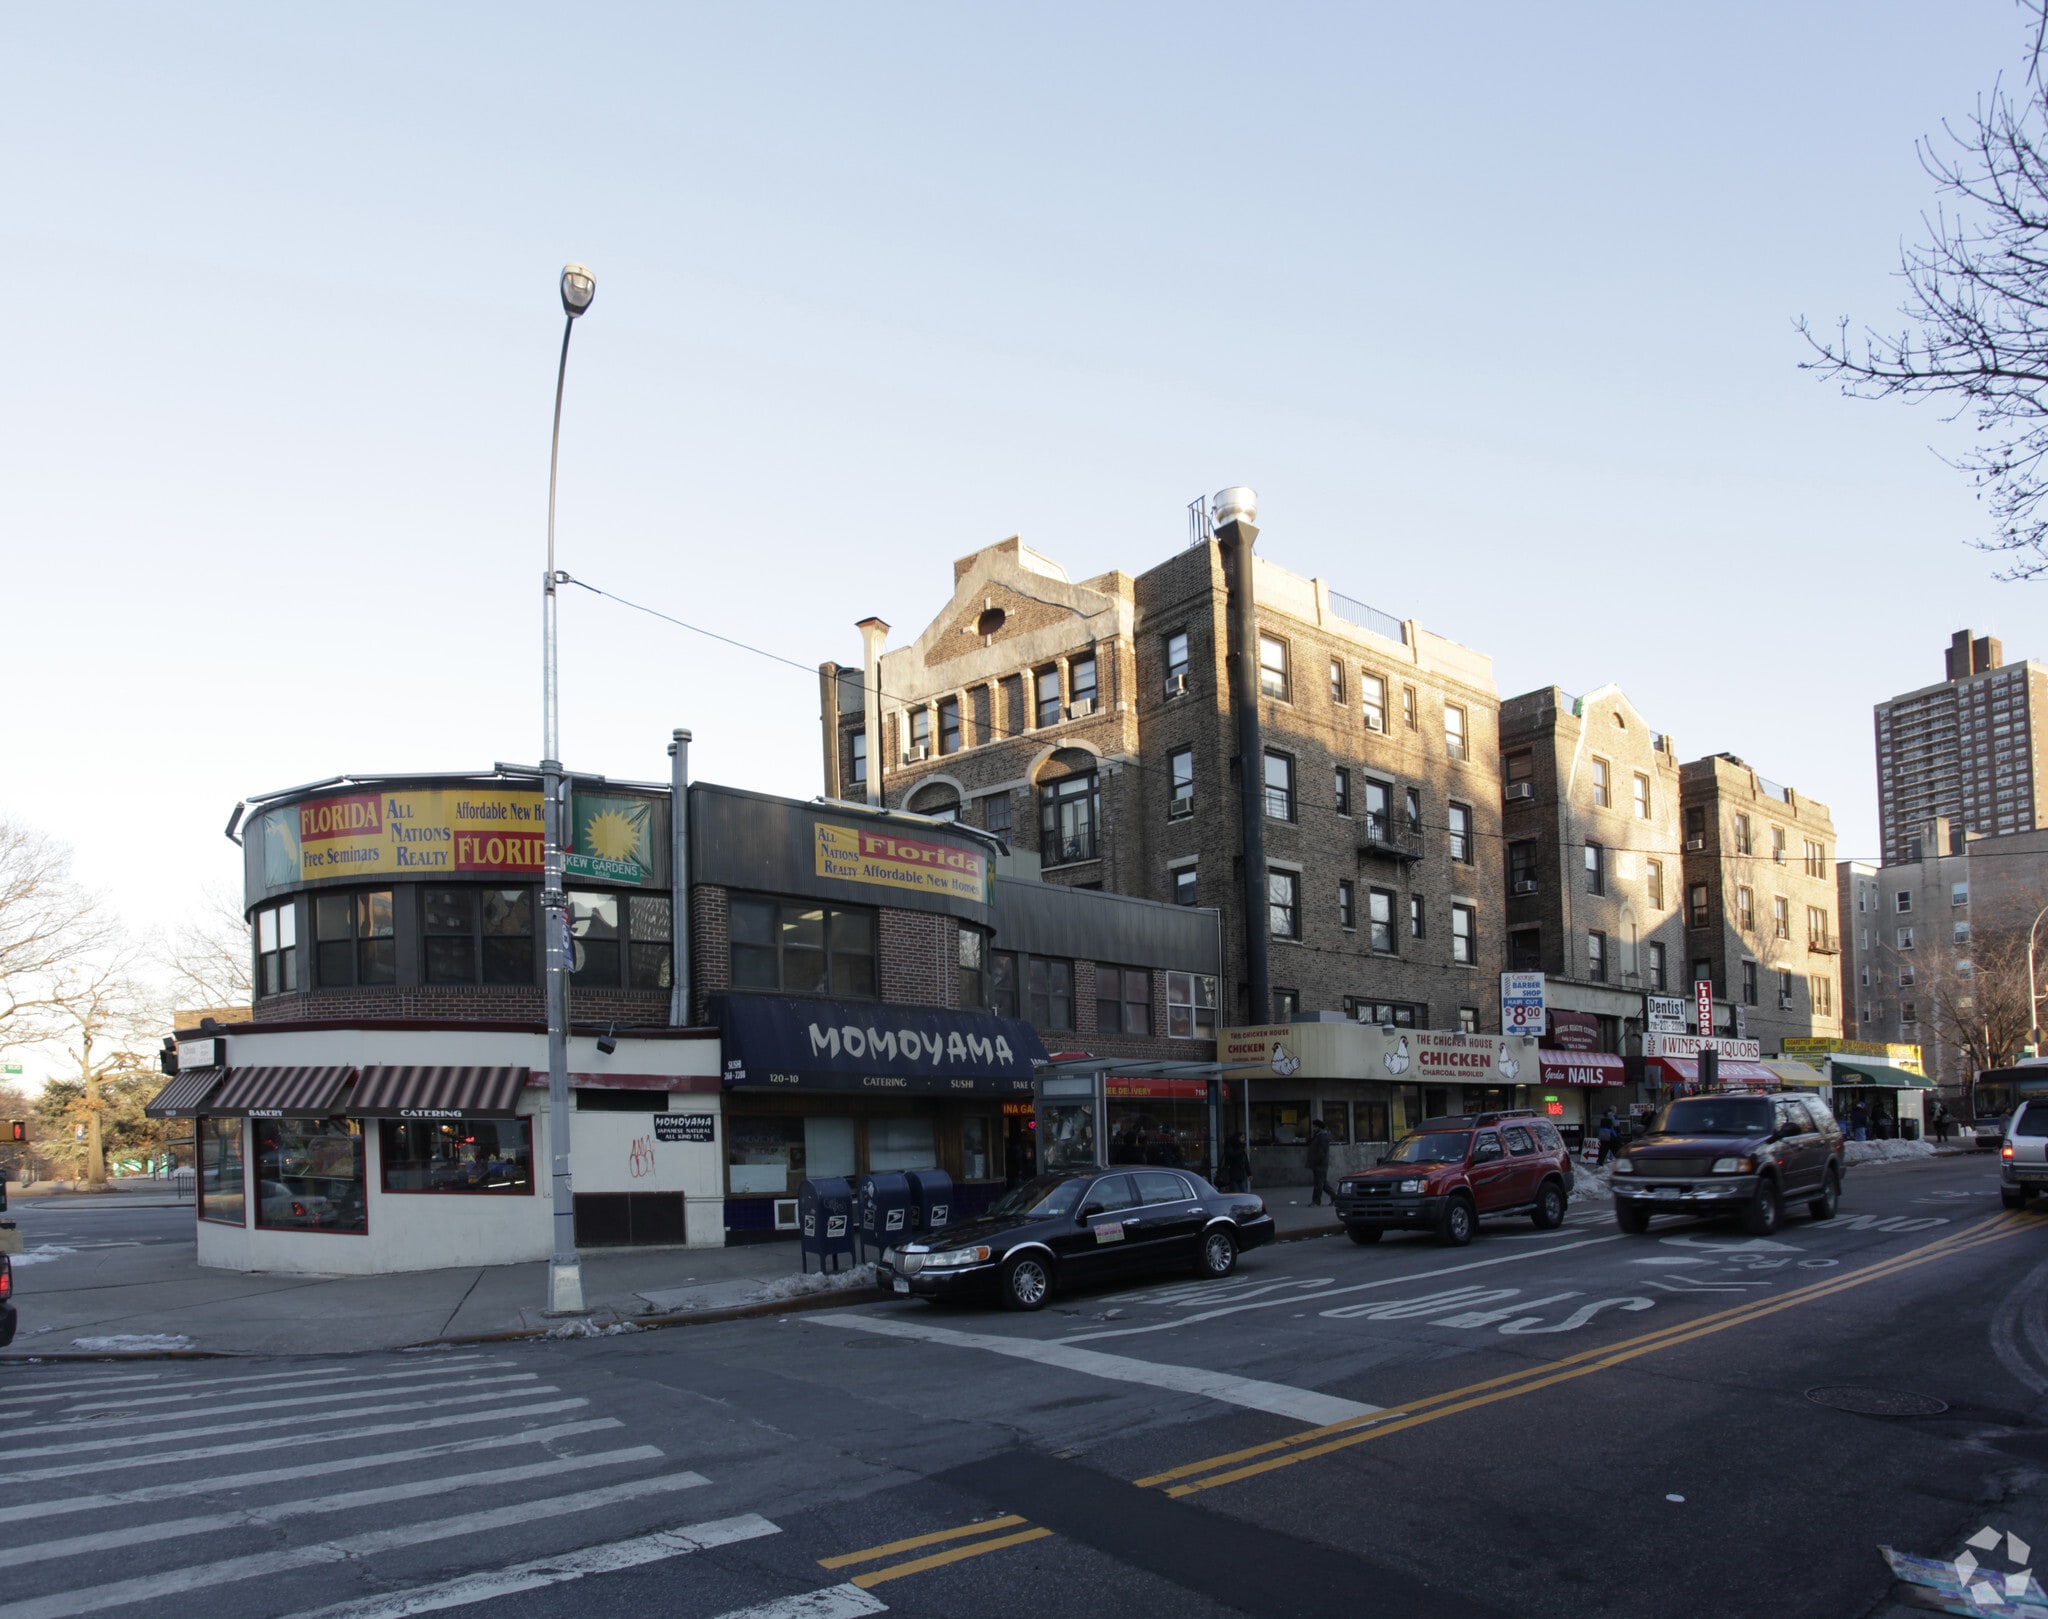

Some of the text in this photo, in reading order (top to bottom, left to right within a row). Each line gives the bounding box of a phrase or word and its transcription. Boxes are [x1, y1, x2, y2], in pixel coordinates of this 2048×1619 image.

[386, 800, 414, 819] ALL
[456, 802, 507, 819] Affordable
[510, 803, 530, 820] New
[301, 802, 379, 835] FLORIDA
[391, 823, 451, 842] NATIONS
[818, 828, 837, 843] ALL
[304, 846, 379, 868] Free Seminars
[396, 846, 448, 866] REALTY
[821, 844, 859, 862] NATIONS
[865, 836, 979, 873] Florida
[566, 855, 638, 877] KEW GARDENS
[825, 860, 858, 877] REALTY
[863, 865, 980, 895] Affordable New Homes
[1649, 998, 1684, 1015] Dentist
[1699, 982, 1711, 1036] LIQUORS
[1243, 1030, 1268, 1038] CHICKEN
[1269, 1028, 1289, 1036] HOUSE
[1416, 1034, 1431, 1045] THE
[1469, 1037, 1493, 1049] HOUSE
[808, 1022, 1014, 1066] MOMOYAMA
[1228, 1043, 1265, 1054] CHICKEN
[1668, 1036, 1759, 1058] WINES & LIQUORS
[1419, 1051, 1491, 1068] CHICKEN
[769, 1073, 799, 1083] 120-10
[1422, 1069, 1484, 1078] CHARCOAL BROILED
[1545, 1067, 1604, 1084] Garden NAILS
[863, 1076, 907, 1088] CATERING
[951, 1079, 974, 1089] SUSHI
[1012, 1080, 1028, 1089] TAKE
[1118, 1087, 1152, 1097] DELIVERY
[248, 1109, 283, 1118] BAKERY
[401, 1109, 462, 1118] CATERING
[1003, 1103, 1018, 1114] INA
[656, 1117, 712, 1128] MOMOYAMA
[1584, 1139, 1601, 1150] NAILS
